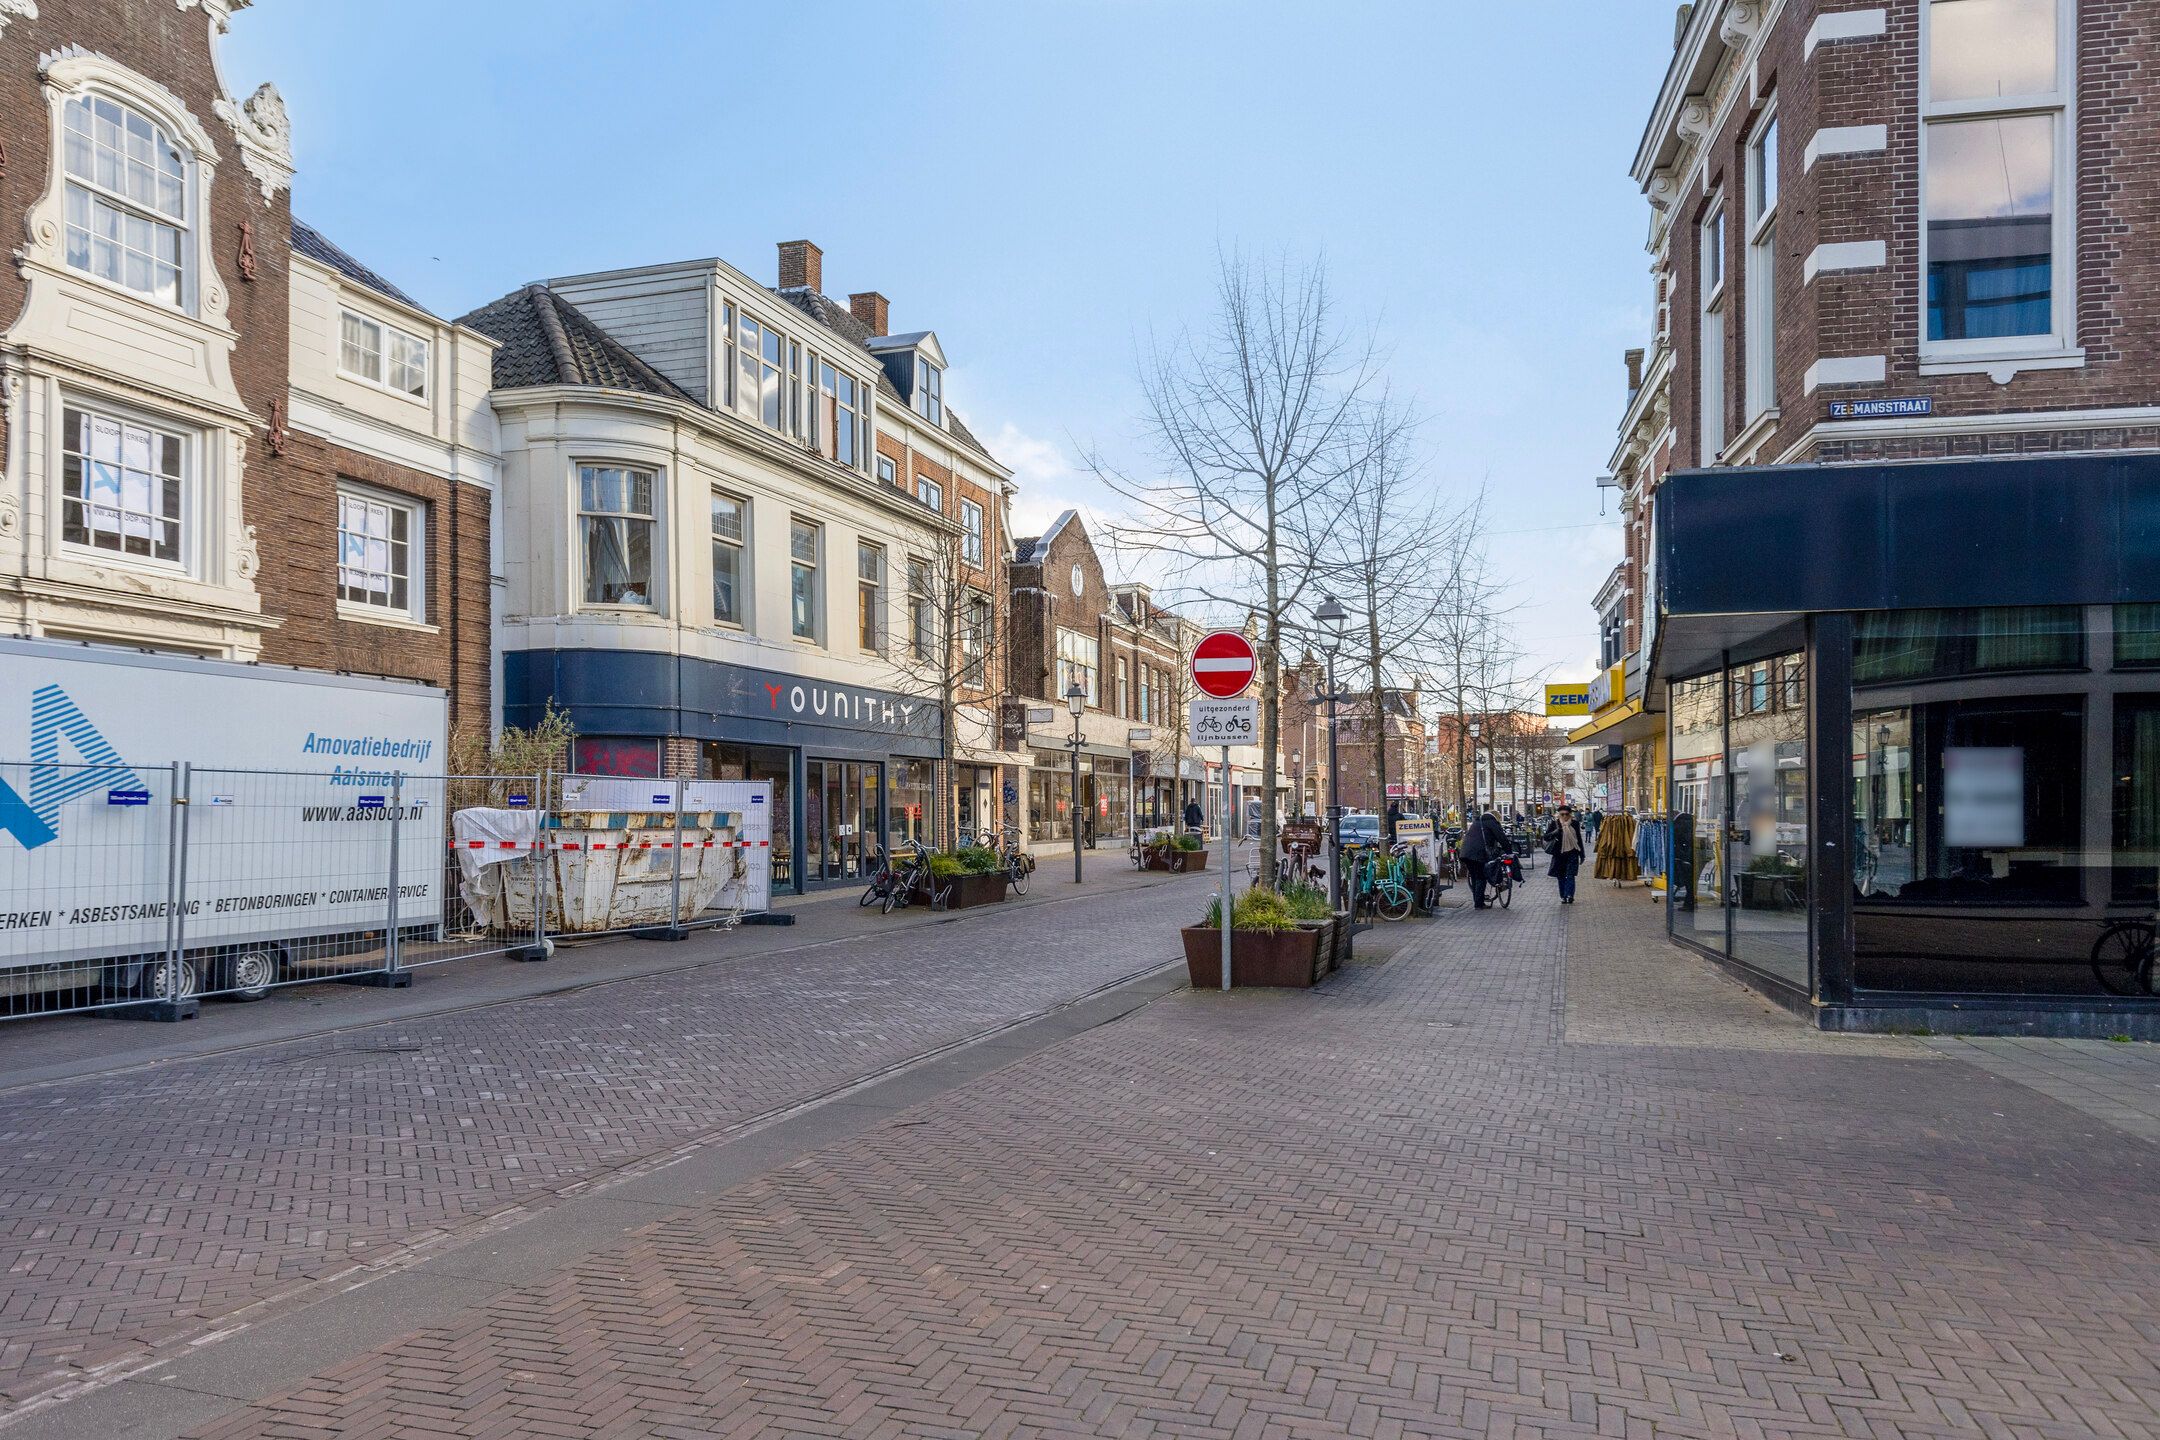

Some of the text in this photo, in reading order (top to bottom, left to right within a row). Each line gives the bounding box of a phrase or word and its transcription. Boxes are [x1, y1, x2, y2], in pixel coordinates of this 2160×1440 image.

[1833, 400, 1928, 416] ZEEMANSSTRAAT
[94, 424, 151, 445] SLOOPERKEN
[1198, 705, 1250, 714] uitgezonderd
[303, 732, 432, 763] Amovatiebedrijf
[329, 765, 408, 788] Aalsmer
[1398, 822, 1431, 830] ZEEMAN
[215, 891, 317, 913] BETONBORINGEN
[329, 884, 428, 904] CONTAINERRVICE
